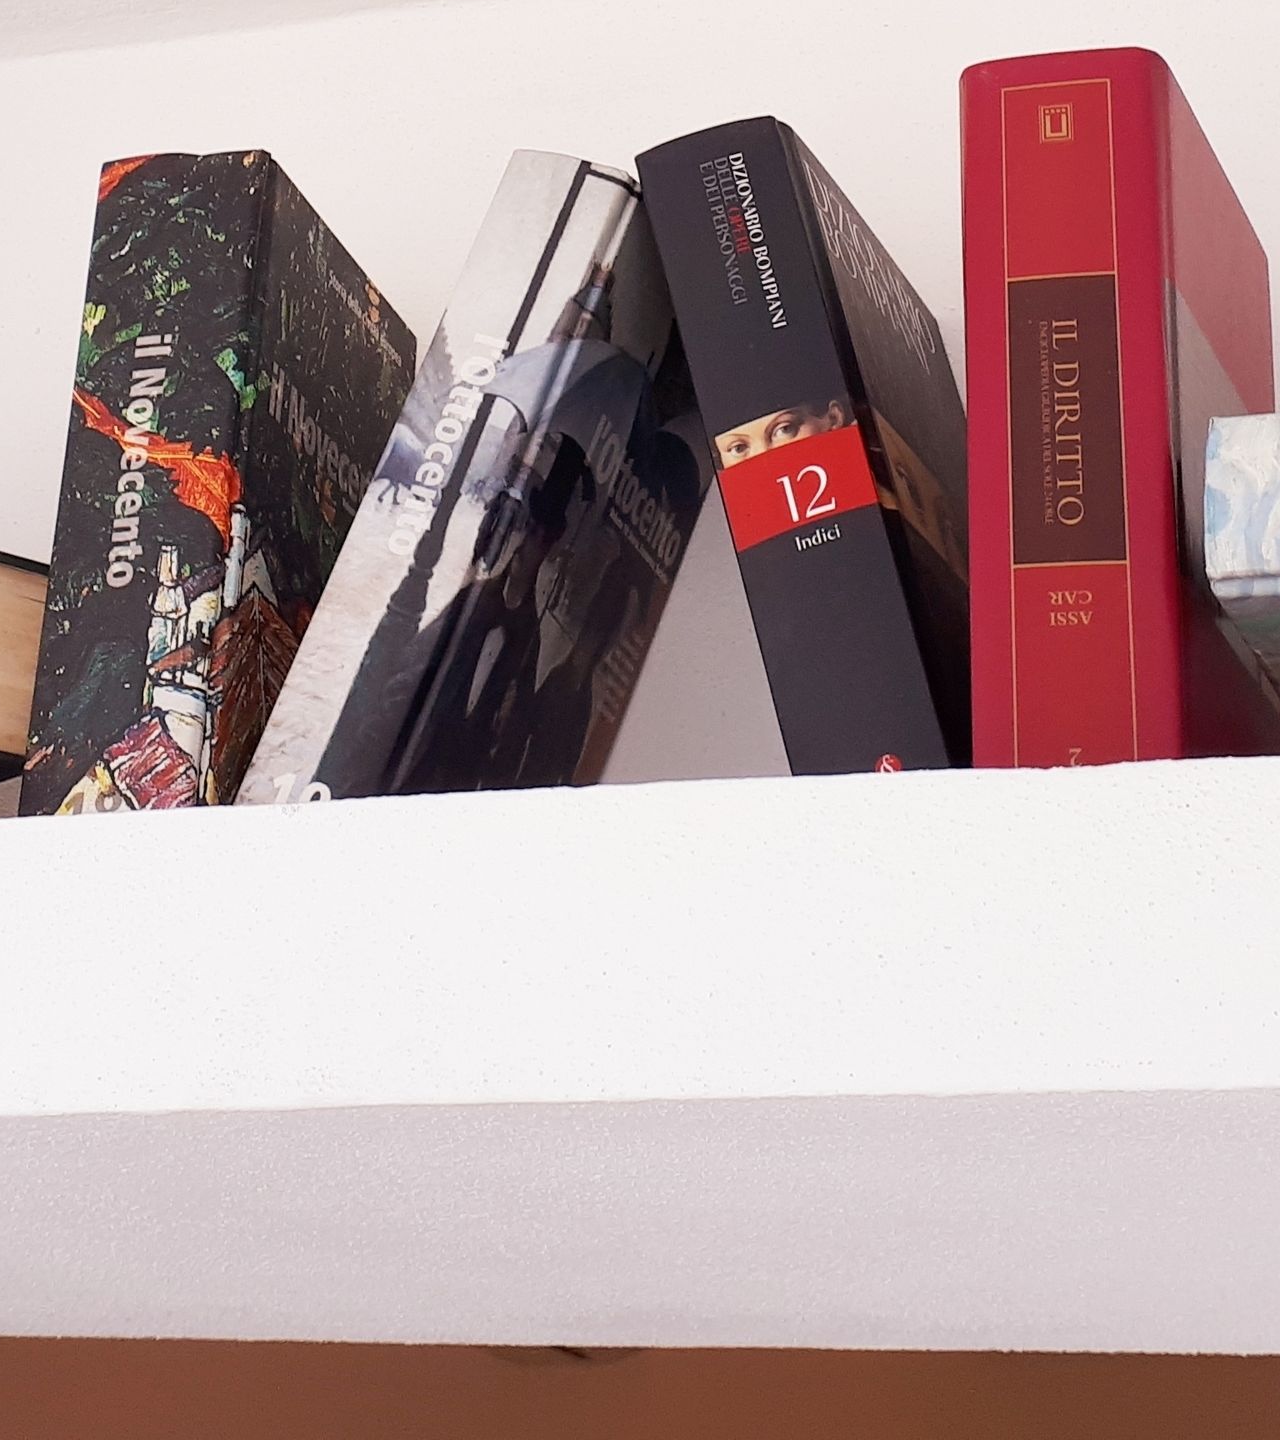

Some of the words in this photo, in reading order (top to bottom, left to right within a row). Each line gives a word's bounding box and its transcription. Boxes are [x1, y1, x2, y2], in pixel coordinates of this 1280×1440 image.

[700, 161, 714, 173] E
[703, 173, 721, 202] DEI
[713, 156, 739, 205] DELLE
[727, 206, 753, 254] OPERE
[710, 202, 749, 304] PERSONAGGI
[728, 152, 764, 243] DIZIONARIO
[752, 245, 788, 329] BOMPIANI
[134, 334, 174, 359] il
[1052, 318, 1079, 352] IL
[1053, 360, 1085, 526] DIRITTO
[104, 367, 167, 589] Novecento
[775, 464, 836, 523] 12
[794, 523, 841, 552] Indici
[1048, 590, 1093, 605] CAR
[1049, 611, 1093, 626] ASSI
